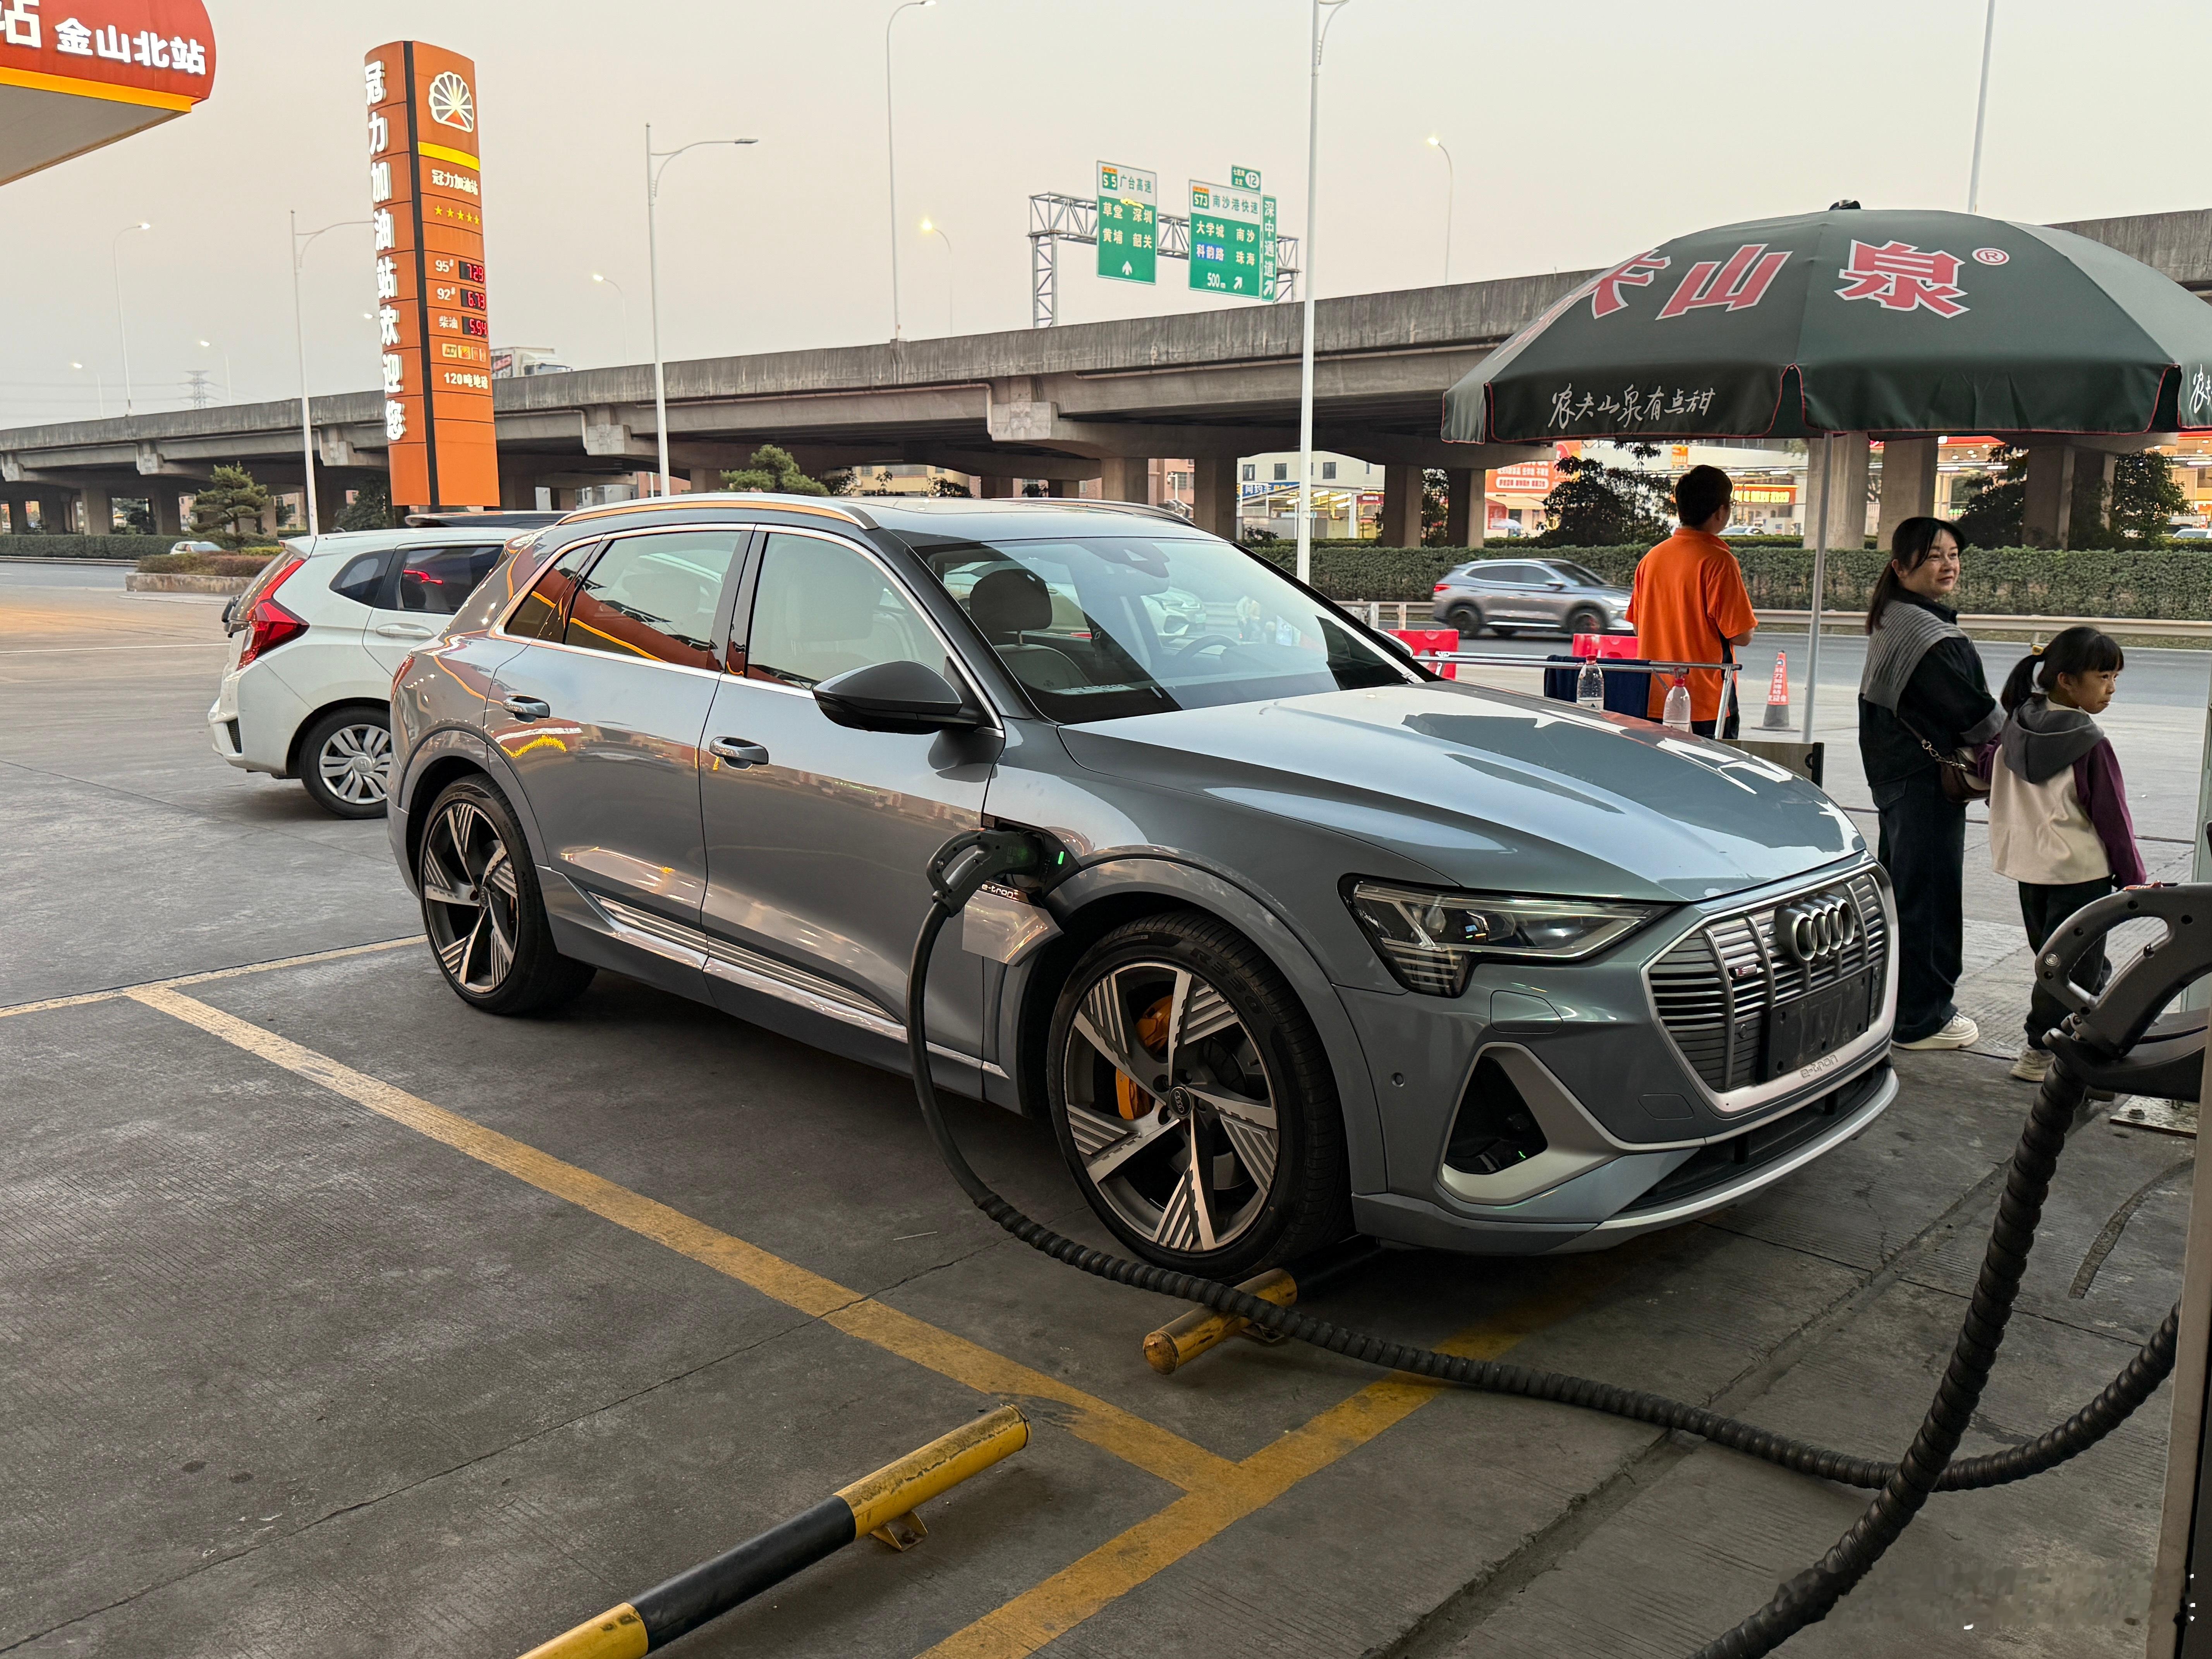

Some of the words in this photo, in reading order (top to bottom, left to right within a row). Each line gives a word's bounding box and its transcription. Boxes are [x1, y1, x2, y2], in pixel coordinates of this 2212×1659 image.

[55, 17, 206, 75] 金山北站
[431, 169, 478, 196] 冠力加油站
[1120, 175, 1151, 193] 广台高速
[1249, 174, 1257, 186] 12
[1194, 194, 1208, 207] S73
[1212, 194, 1258, 214] 南沙港快速
[1133, 208, 1152, 224] 深圳
[1103, 228, 1123, 244] 黄埔
[1133, 233, 1152, 249] 韶关
[1196, 220, 1224, 238] 大学城
[1236, 228, 1255, 243] 南沙
[1264, 200, 1274, 277] 深中通道
[364, 60, 406, 440] 冠力加油站欢迎您
[1197, 244, 1224, 261] 科韵路
[1236, 251, 1255, 266] 珠海
[467, 291, 486, 309] 6.73
[439, 316, 458, 329] 柴油
[469, 319, 488, 336] 5.94
[1548, 383, 1716, 429] 农夫山泉有点甜
[981, 884, 1014, 899] e-tron
[1800, 1054, 1838, 1079] e-tron
